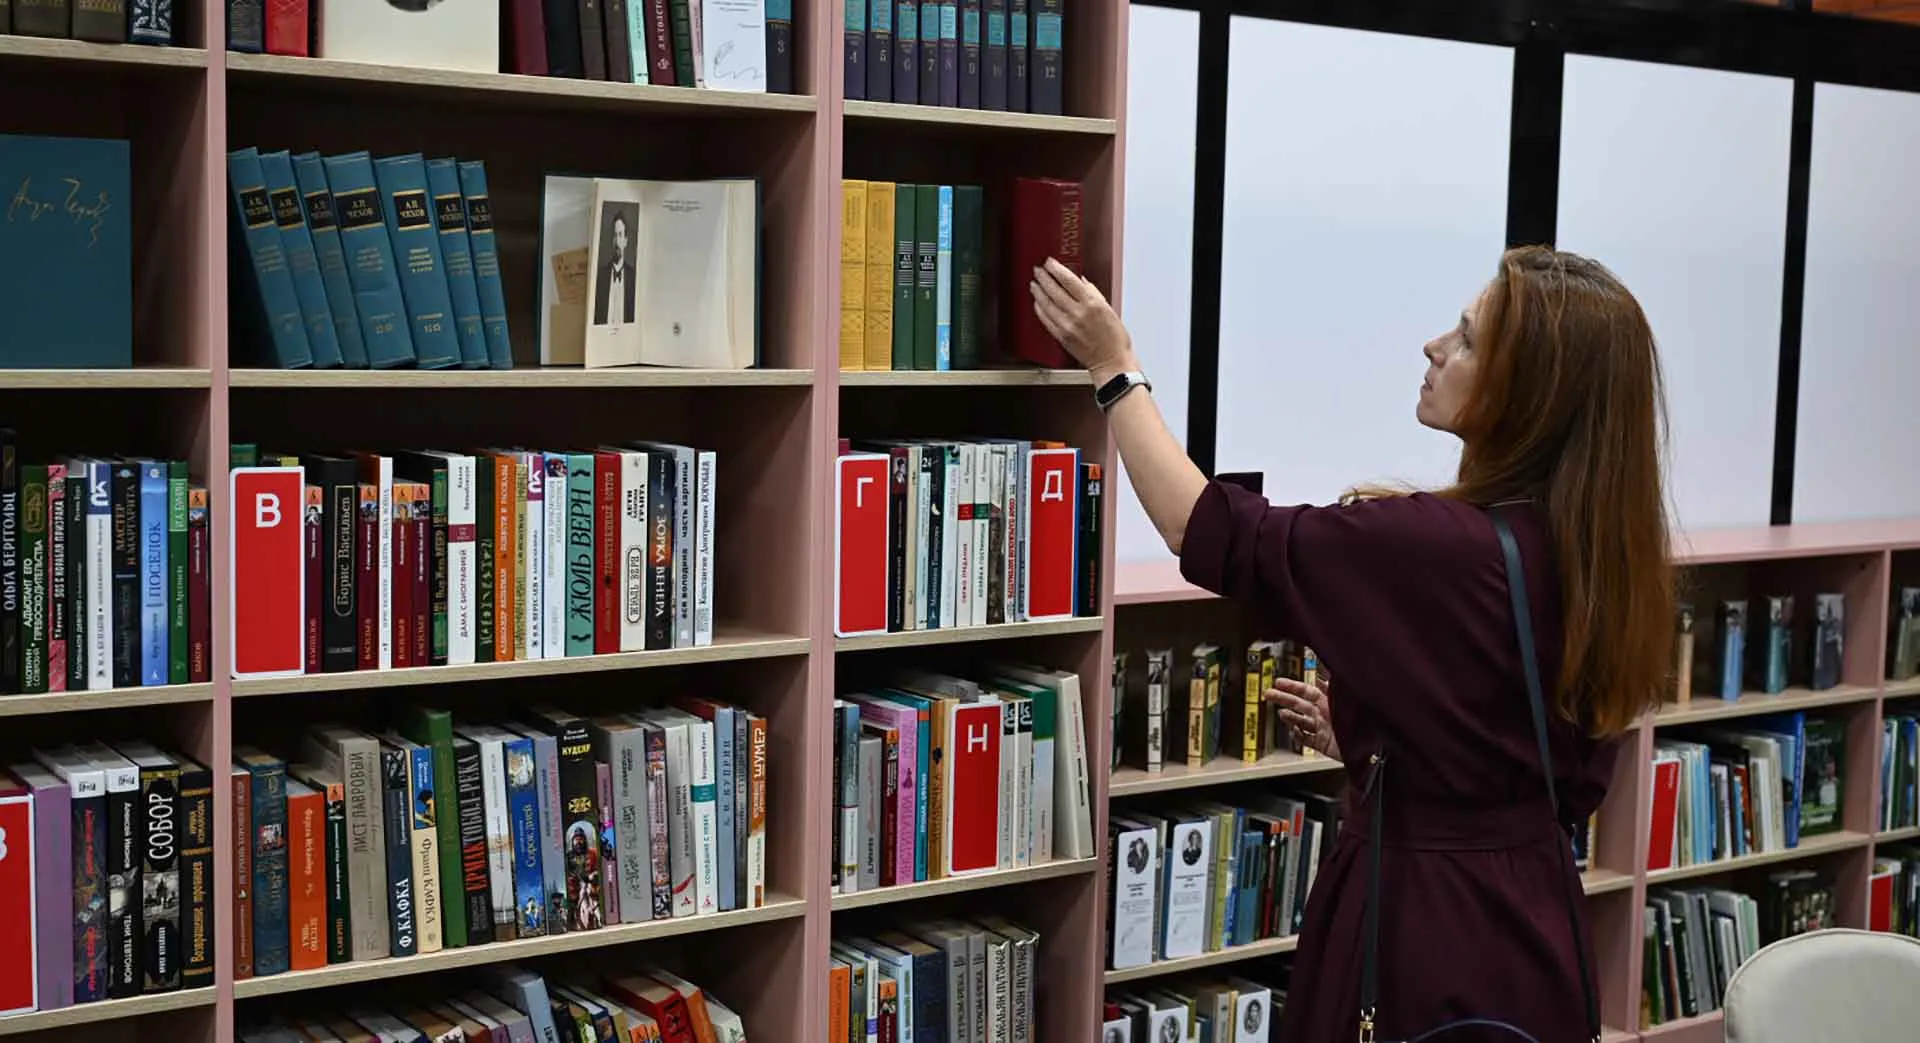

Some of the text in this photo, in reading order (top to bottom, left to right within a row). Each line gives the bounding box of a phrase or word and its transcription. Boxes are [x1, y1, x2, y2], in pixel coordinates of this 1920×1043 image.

[927, 59, 935, 71] 7
[399, 208, 426, 218] ЧЕХОВ
[256, 493, 281, 528] В
[857, 477, 874, 508] Г
[1041, 470, 1063, 502] Д
[55, 501, 65, 541] ПРИЗРАКА
[115, 504, 125, 551] МАСТЕР
[126, 484, 136, 556] МАРГАРИТА
[3, 492, 16, 610] ОЛЬГА БЕРГГОЛЬЦ
[24, 559, 32, 575] ЕГО
[55, 543, 65, 575] КОРАБЛЯ
[148, 521, 161, 598] ПОСЕЛОК
[337, 496, 351, 605] Борис Васильев
[571, 488, 591, 623] ЖЮЛЬ ВЕРН
[656, 516, 666, 617] ЗОРКА ВЕНЕРА
[681, 548, 689, 599] володина
[34, 540, 44, 640] ПРЕВОСХОДИТЕЛЬСТВА
[55, 584, 65, 598] SOS
[754, 727, 766, 777] ШУМЕР
[968, 724, 988, 753] Н
[348, 752, 369, 853] ЛИСТ ЛАВРОВЫЙ
[421, 838, 436, 924] Франц КАФКА
[462, 841, 489, 892] ЕРМАК
[394, 878, 412, 948] Ф.КАФКА
[123, 914, 132, 983] ТЕНИ ТЕВТОНОВ
